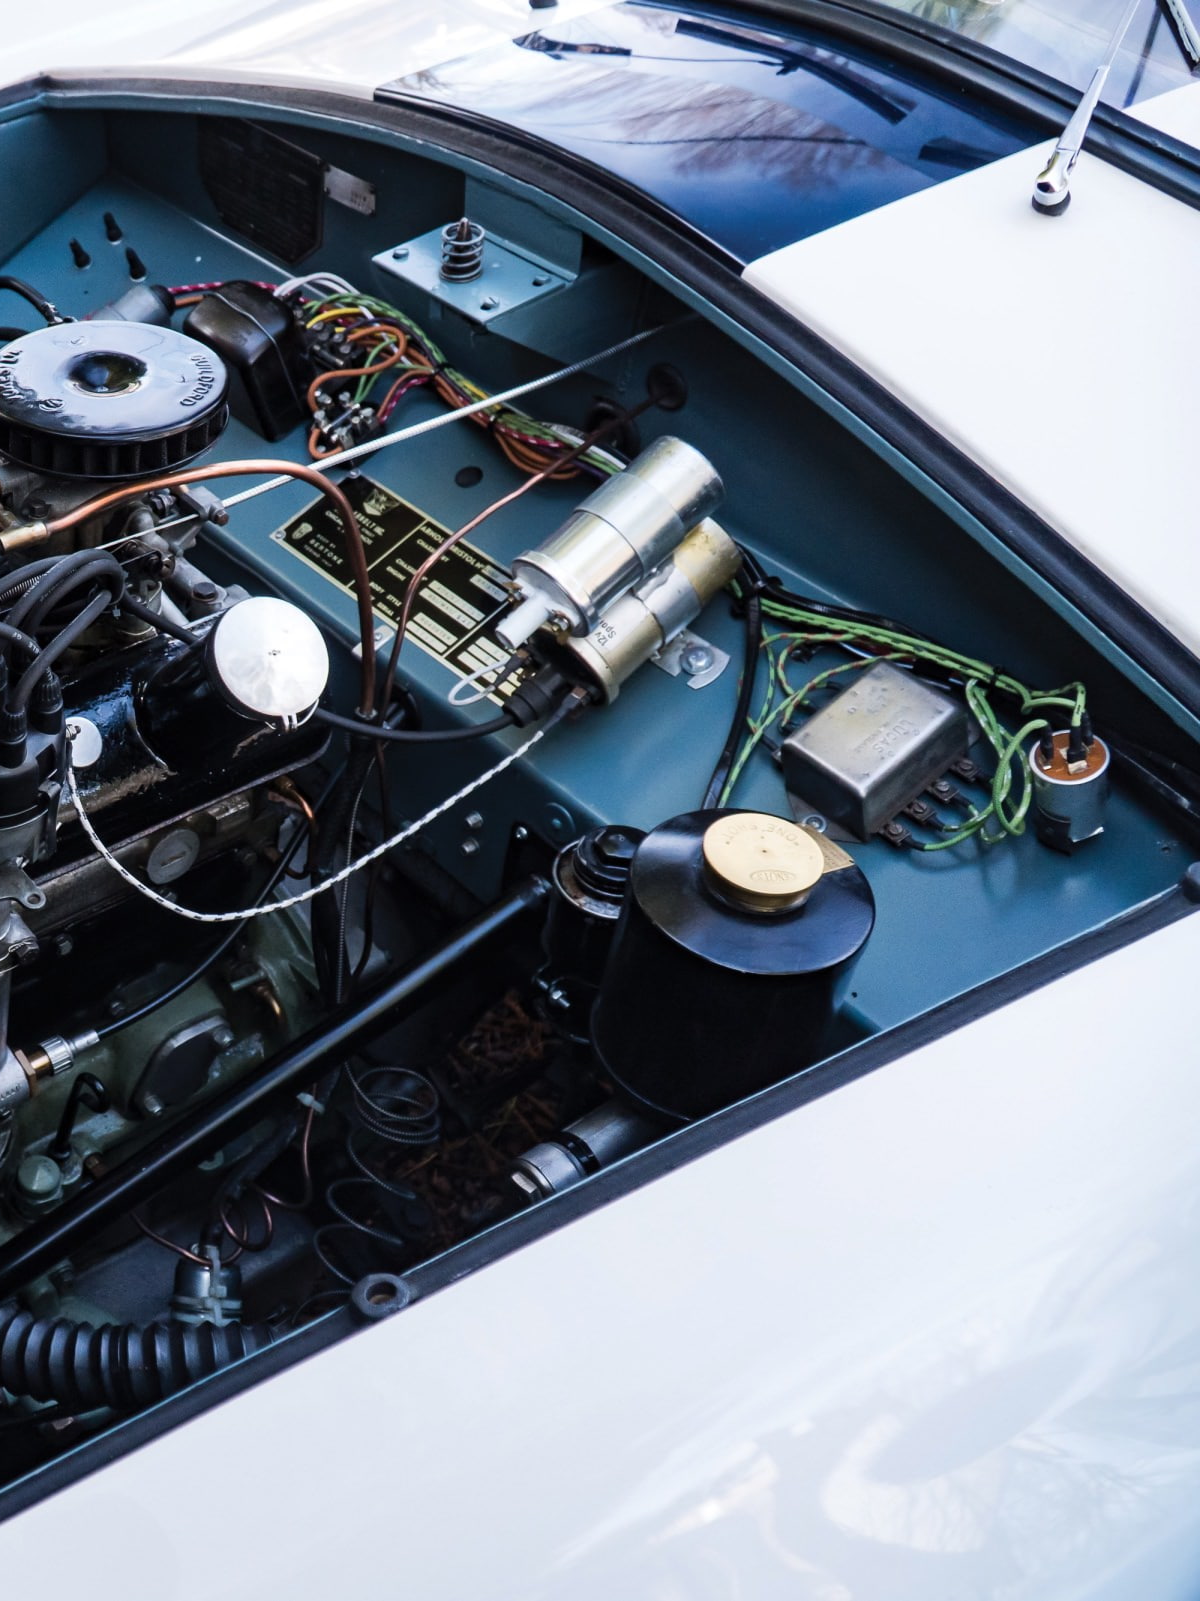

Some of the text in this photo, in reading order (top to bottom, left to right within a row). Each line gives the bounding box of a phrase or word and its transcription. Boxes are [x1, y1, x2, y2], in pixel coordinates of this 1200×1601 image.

[179, 352, 216, 407] GUILDFORD
[420, 525, 445, 544] ARNOL
[308, 538, 343, 566] BERTONE
[386, 594, 403, 608] STYLE
[871, 717, 916, 754] LUCAS
